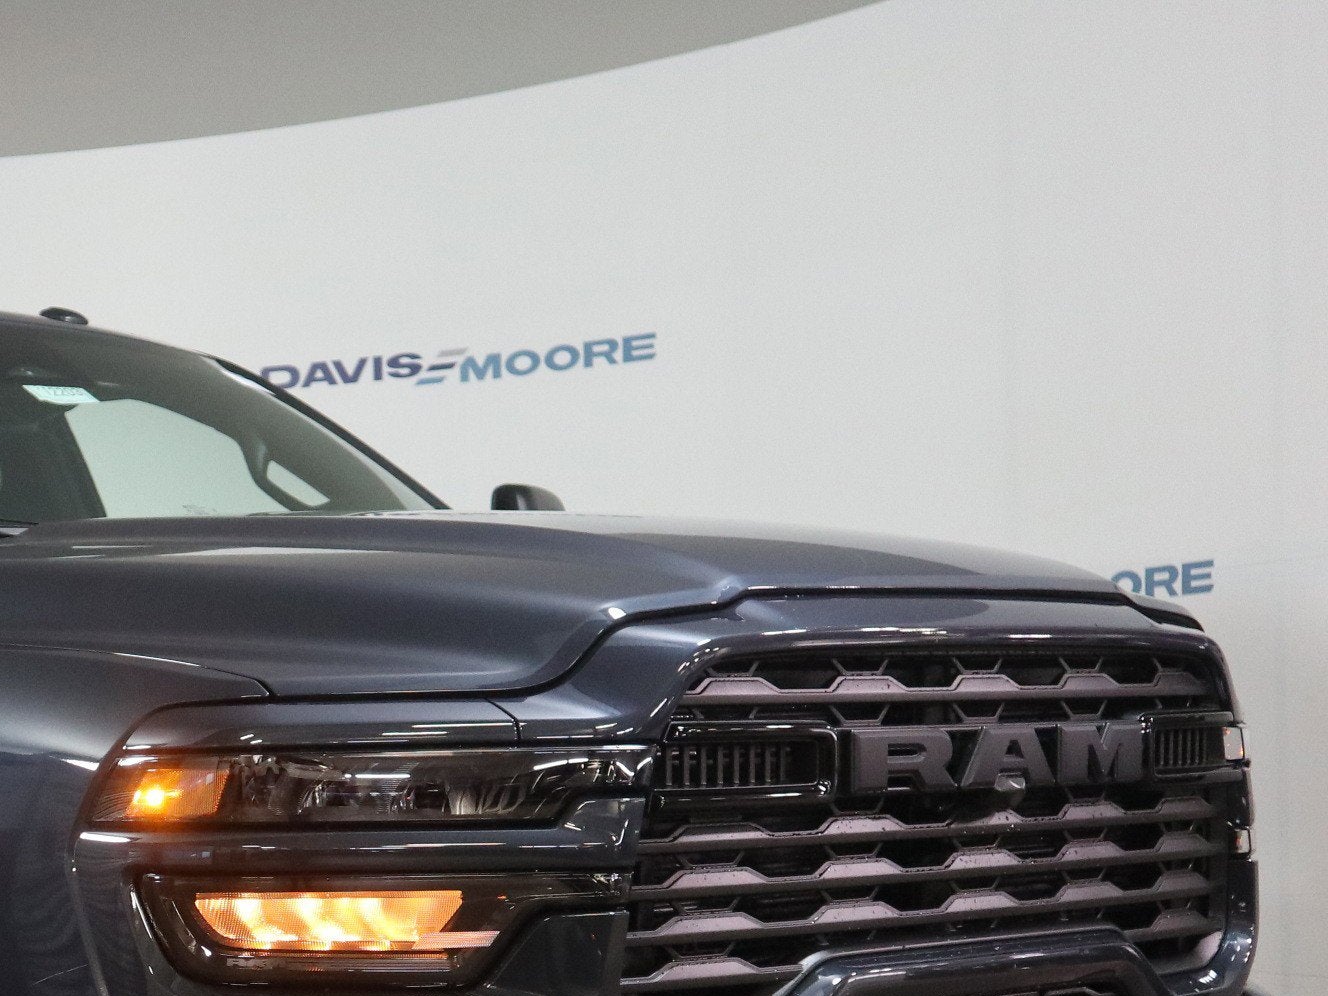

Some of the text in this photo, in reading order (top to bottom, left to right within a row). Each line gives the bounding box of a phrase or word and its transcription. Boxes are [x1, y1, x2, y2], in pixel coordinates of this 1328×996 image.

[260, 332, 657, 390] DAVIS MOORE
[850, 723, 1144, 794] RAM
